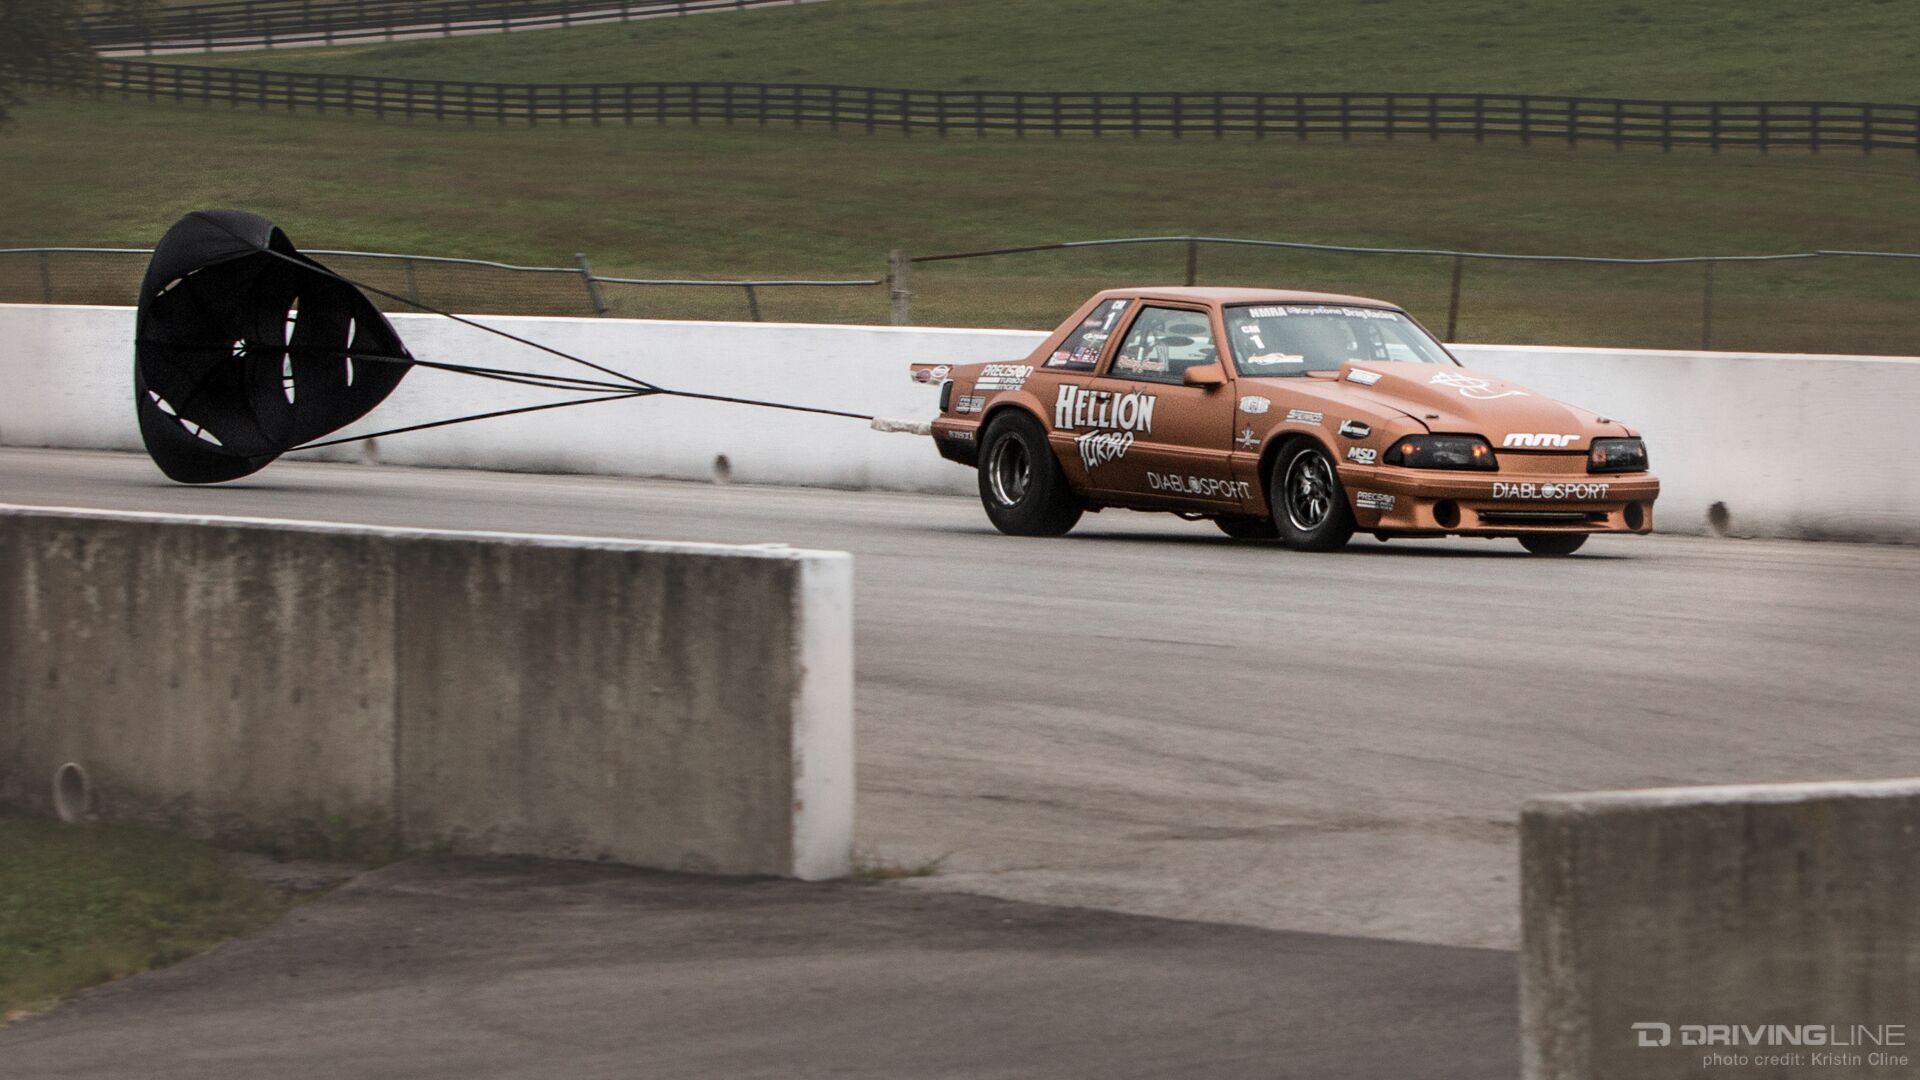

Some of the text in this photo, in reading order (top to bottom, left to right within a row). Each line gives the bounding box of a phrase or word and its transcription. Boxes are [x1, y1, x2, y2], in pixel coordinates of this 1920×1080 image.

[1249, 307, 1288, 318] NMRA
[1103, 312, 1116, 331] 1
[1250, 335, 1265, 349] 1
[980, 364, 1034, 378] PRECISION
[1055, 384, 1157, 434] HELLION
[1503, 433, 1581, 447] mmr
[1073, 429, 1135, 473] TURBO
[1348, 447, 1377, 461] MSD
[1147, 471, 1251, 499] DIABLOSPORT
[1492, 482, 1610, 500] DIABLOSPORT
